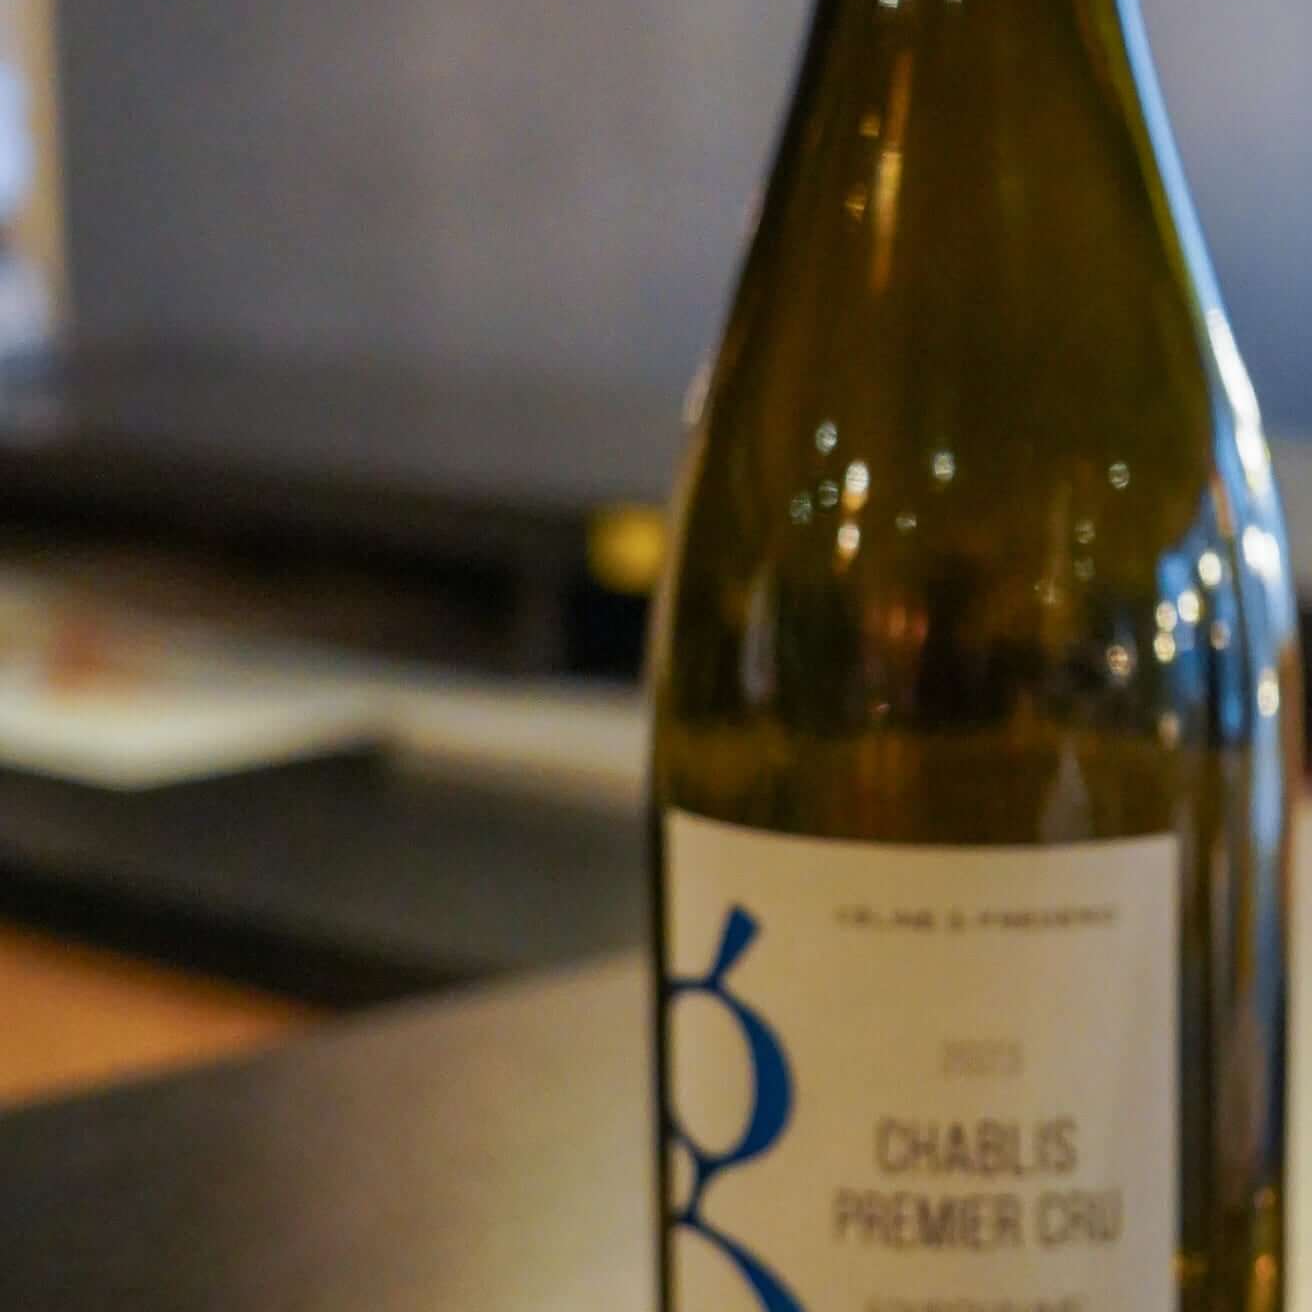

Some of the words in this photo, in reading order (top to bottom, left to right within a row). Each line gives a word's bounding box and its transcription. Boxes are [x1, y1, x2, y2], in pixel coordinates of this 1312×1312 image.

[875, 1118, 1079, 1176] CHABLIS
[835, 1186, 1024, 1251] PREMIER
[1036, 1186, 1122, 1247] CRU
